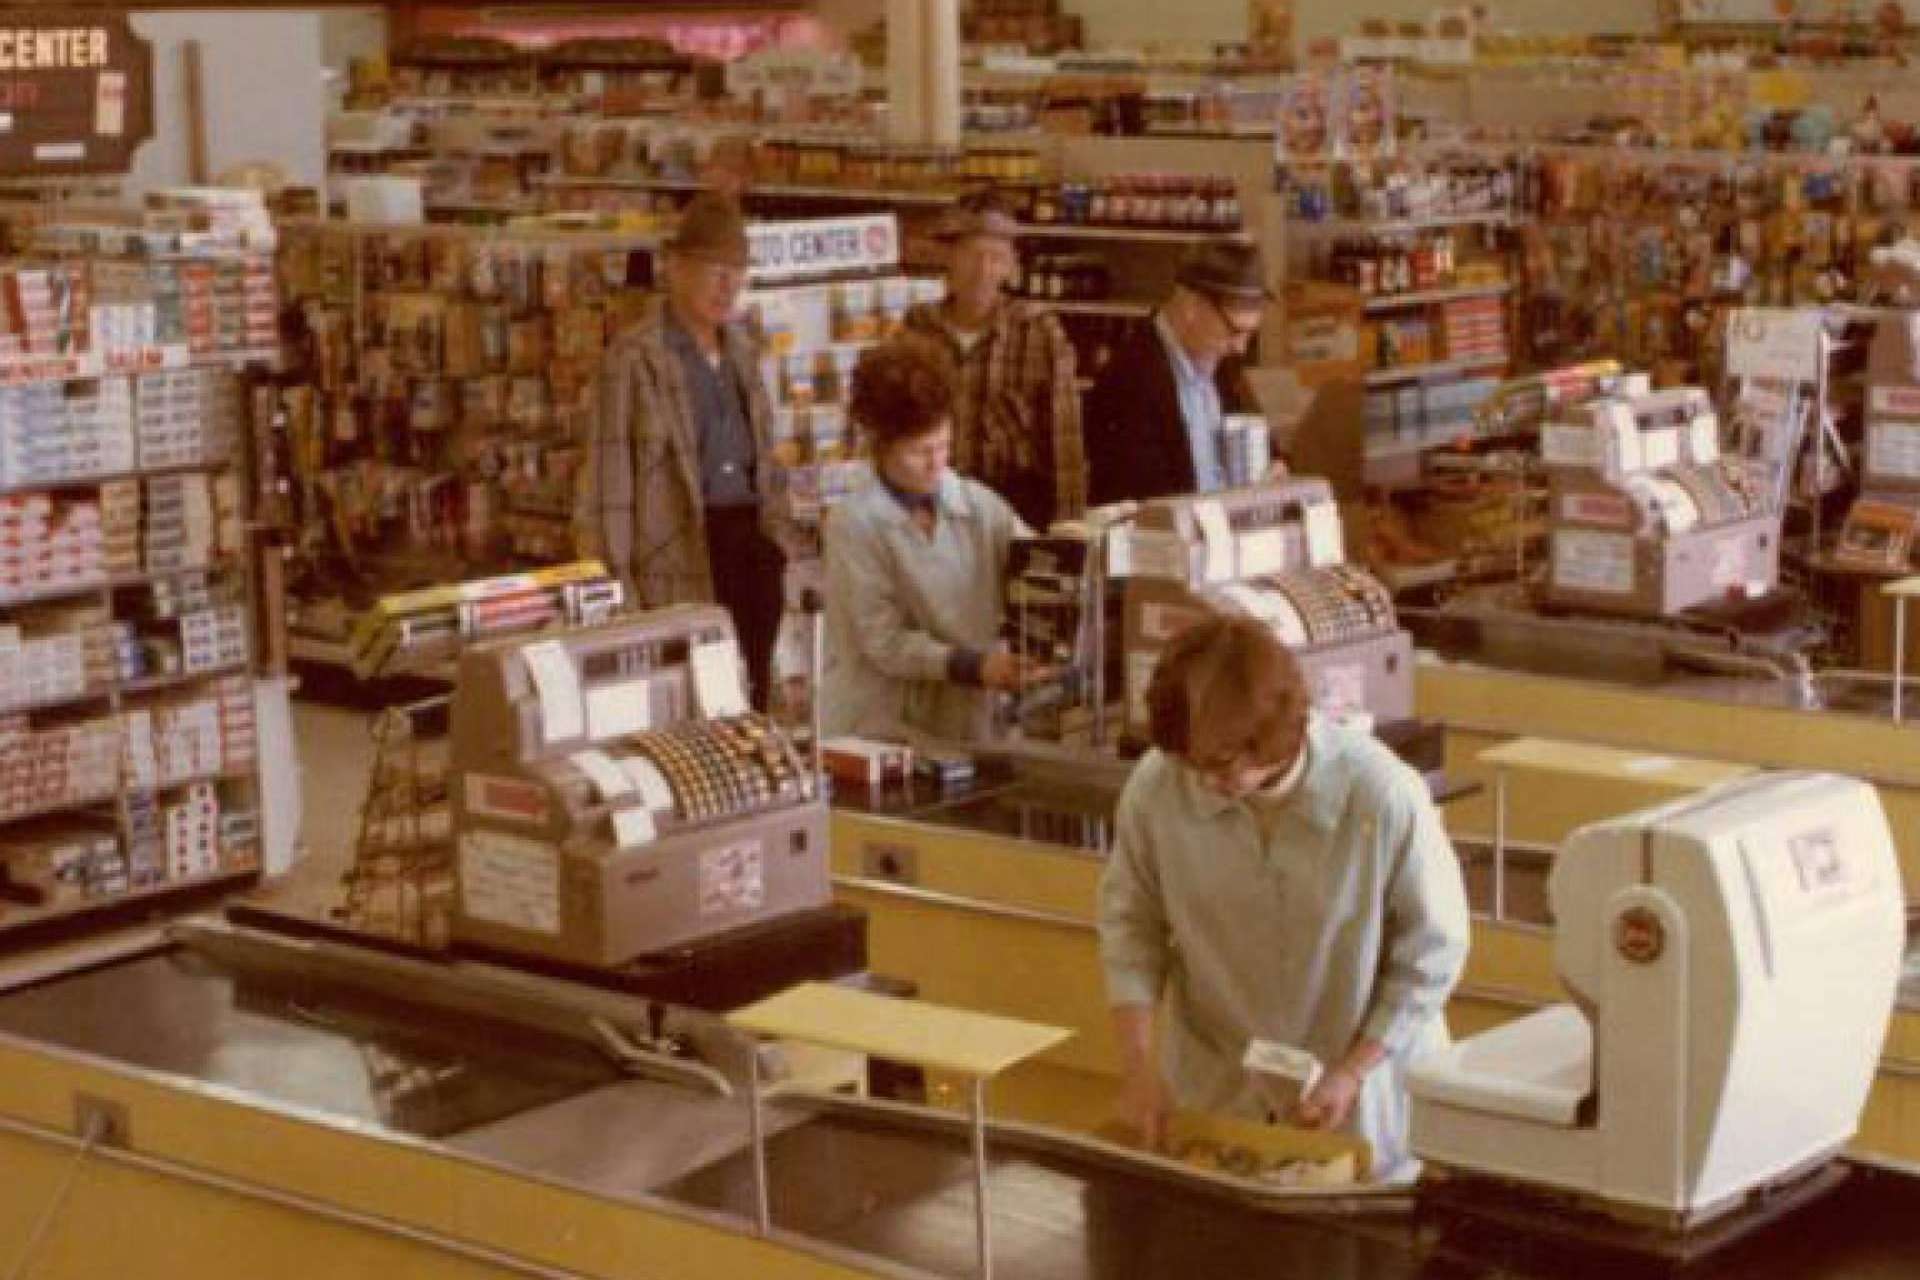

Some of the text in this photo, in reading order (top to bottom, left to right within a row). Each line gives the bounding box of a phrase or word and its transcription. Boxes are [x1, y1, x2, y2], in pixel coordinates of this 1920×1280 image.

[0, 27, 108, 69] CENTER
[748, 232, 785, 266] UTO
[789, 228, 860, 264] CENTER
